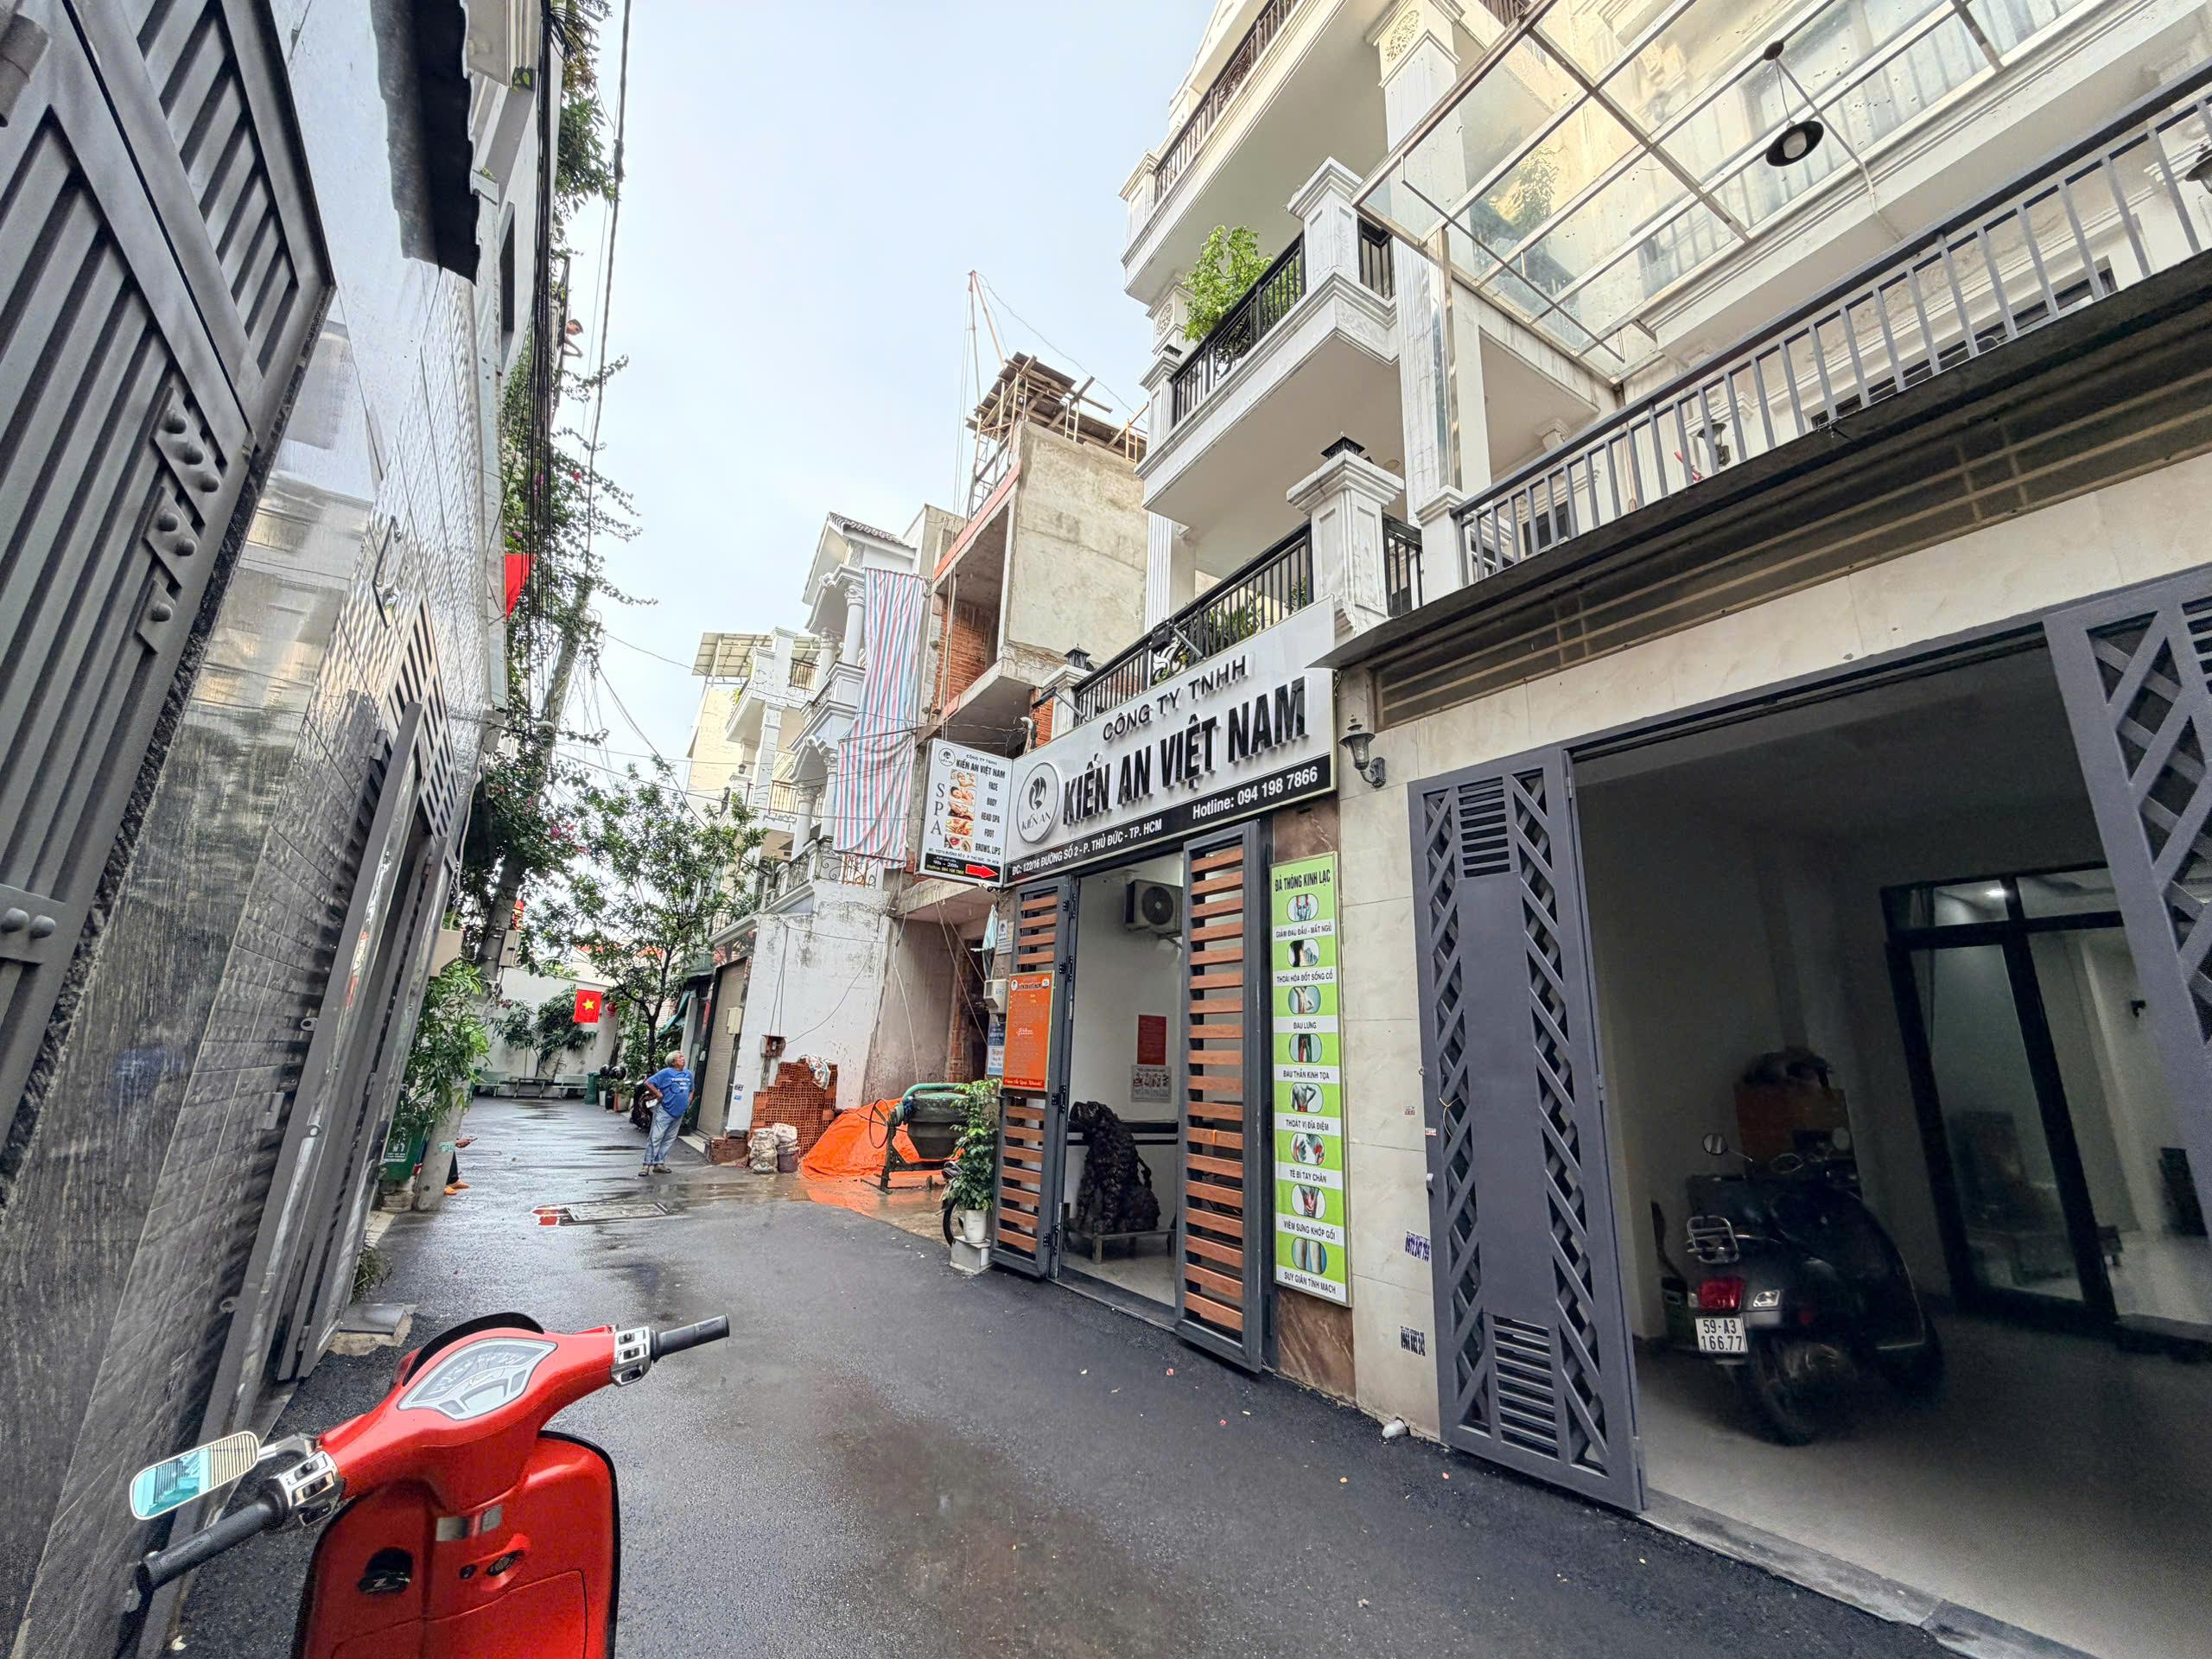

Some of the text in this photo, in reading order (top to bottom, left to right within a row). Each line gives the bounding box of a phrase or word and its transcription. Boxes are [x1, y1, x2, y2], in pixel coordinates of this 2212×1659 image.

[1103, 655, 1248, 741] CÔNG TY TNHH
[1063, 676, 1306, 825] KIẾN AN VIỆT NAM
[970, 762, 978, 772] AN
[993, 769, 1006, 779] NAM
[1192, 766, 1319, 820] Hotline: 094 198 7866
[1040, 850, 1063, 868] ĐƯỜNG
[1064, 844, 1073, 860] SỐ
[1084, 843, 1090, 854] P.
[1091, 836, 1106, 851] THỦ
[1108, 830, 1123, 847] ĐỨC
[1129, 826, 1141, 840] TP.
[1144, 819, 1163, 836] HCM
[1284, 874, 1301, 890] THÔNG
[1303, 872, 1319, 887] KINH
[1319, 869, 1331, 887] LẠC
[1302, 1172, 1312, 1181] TAY
[1700, 1335, 1743, 1351] 166.77
